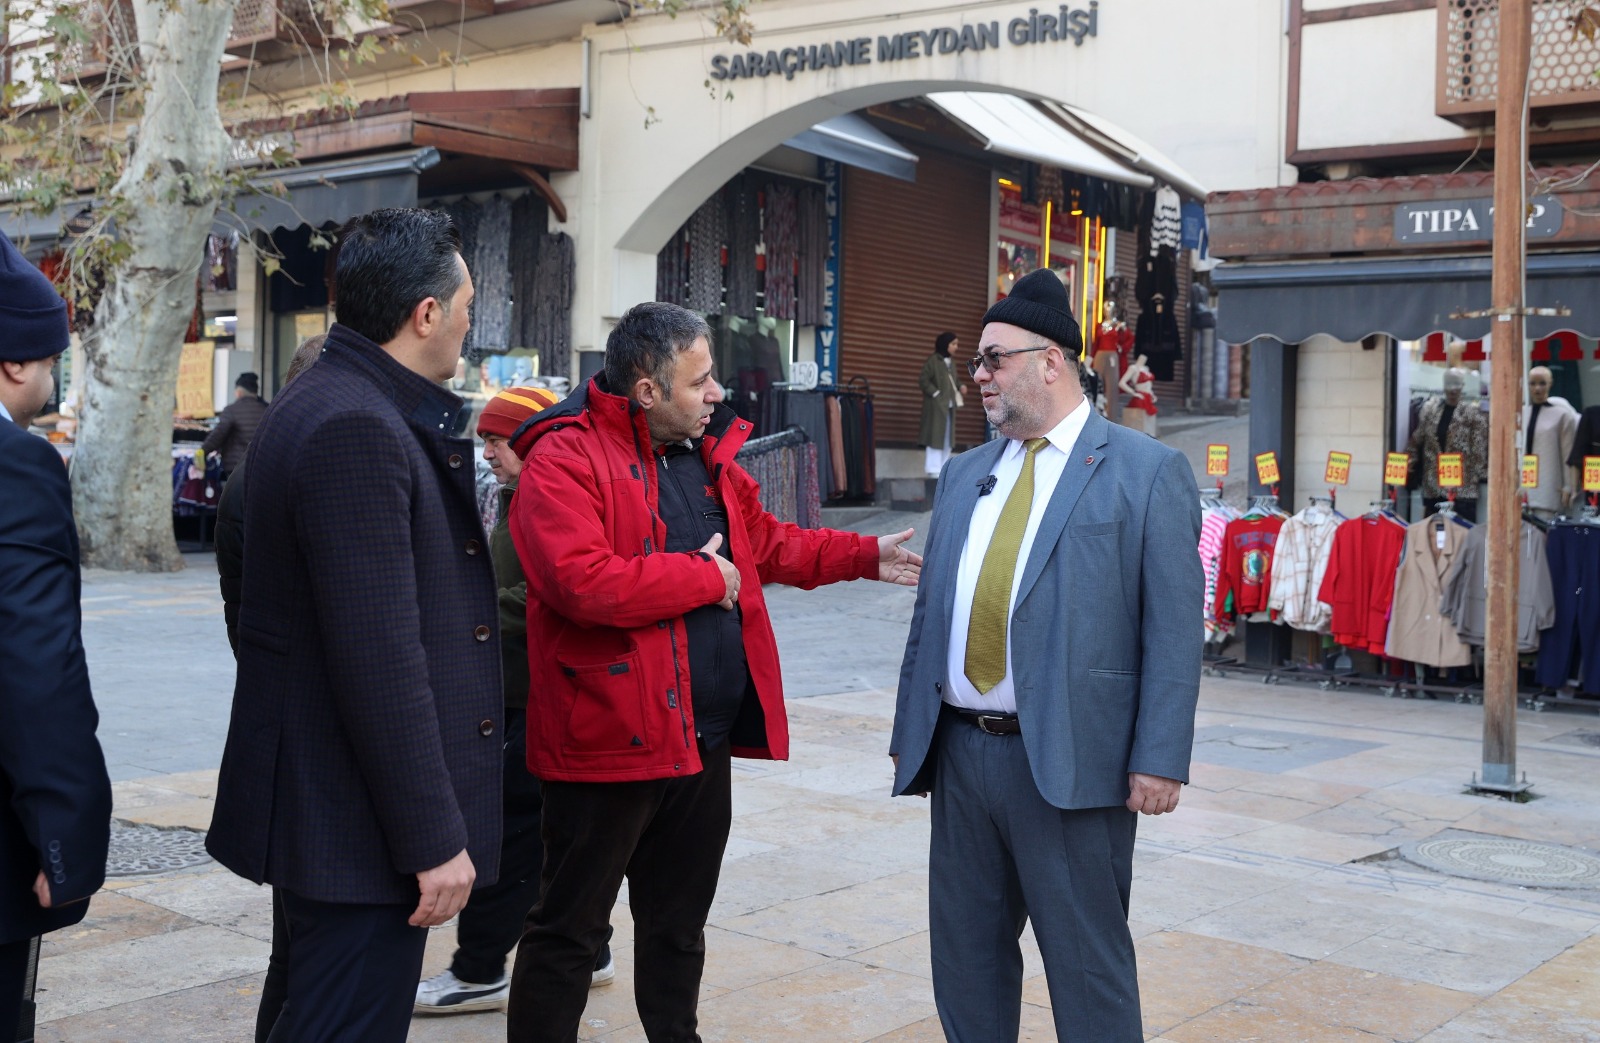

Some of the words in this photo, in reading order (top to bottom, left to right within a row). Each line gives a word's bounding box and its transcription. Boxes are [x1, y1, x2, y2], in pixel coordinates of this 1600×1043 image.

[710, 37, 871, 81] SARAÇHANE
[877, 20, 999, 63] MEYDAN
[1007, 0, 1099, 47] GİRİŞİ
[1408, 207, 1480, 234] TIPA
[792, 363, 816, 386] 150
[1209, 458, 1228, 473] 200
[1259, 464, 1277, 480] 200
[1326, 464, 1346, 481] 350
[1385, 464, 1406, 479] 300
[1438, 464, 1460, 479] 490
[1522, 469, 1535, 484] 90
